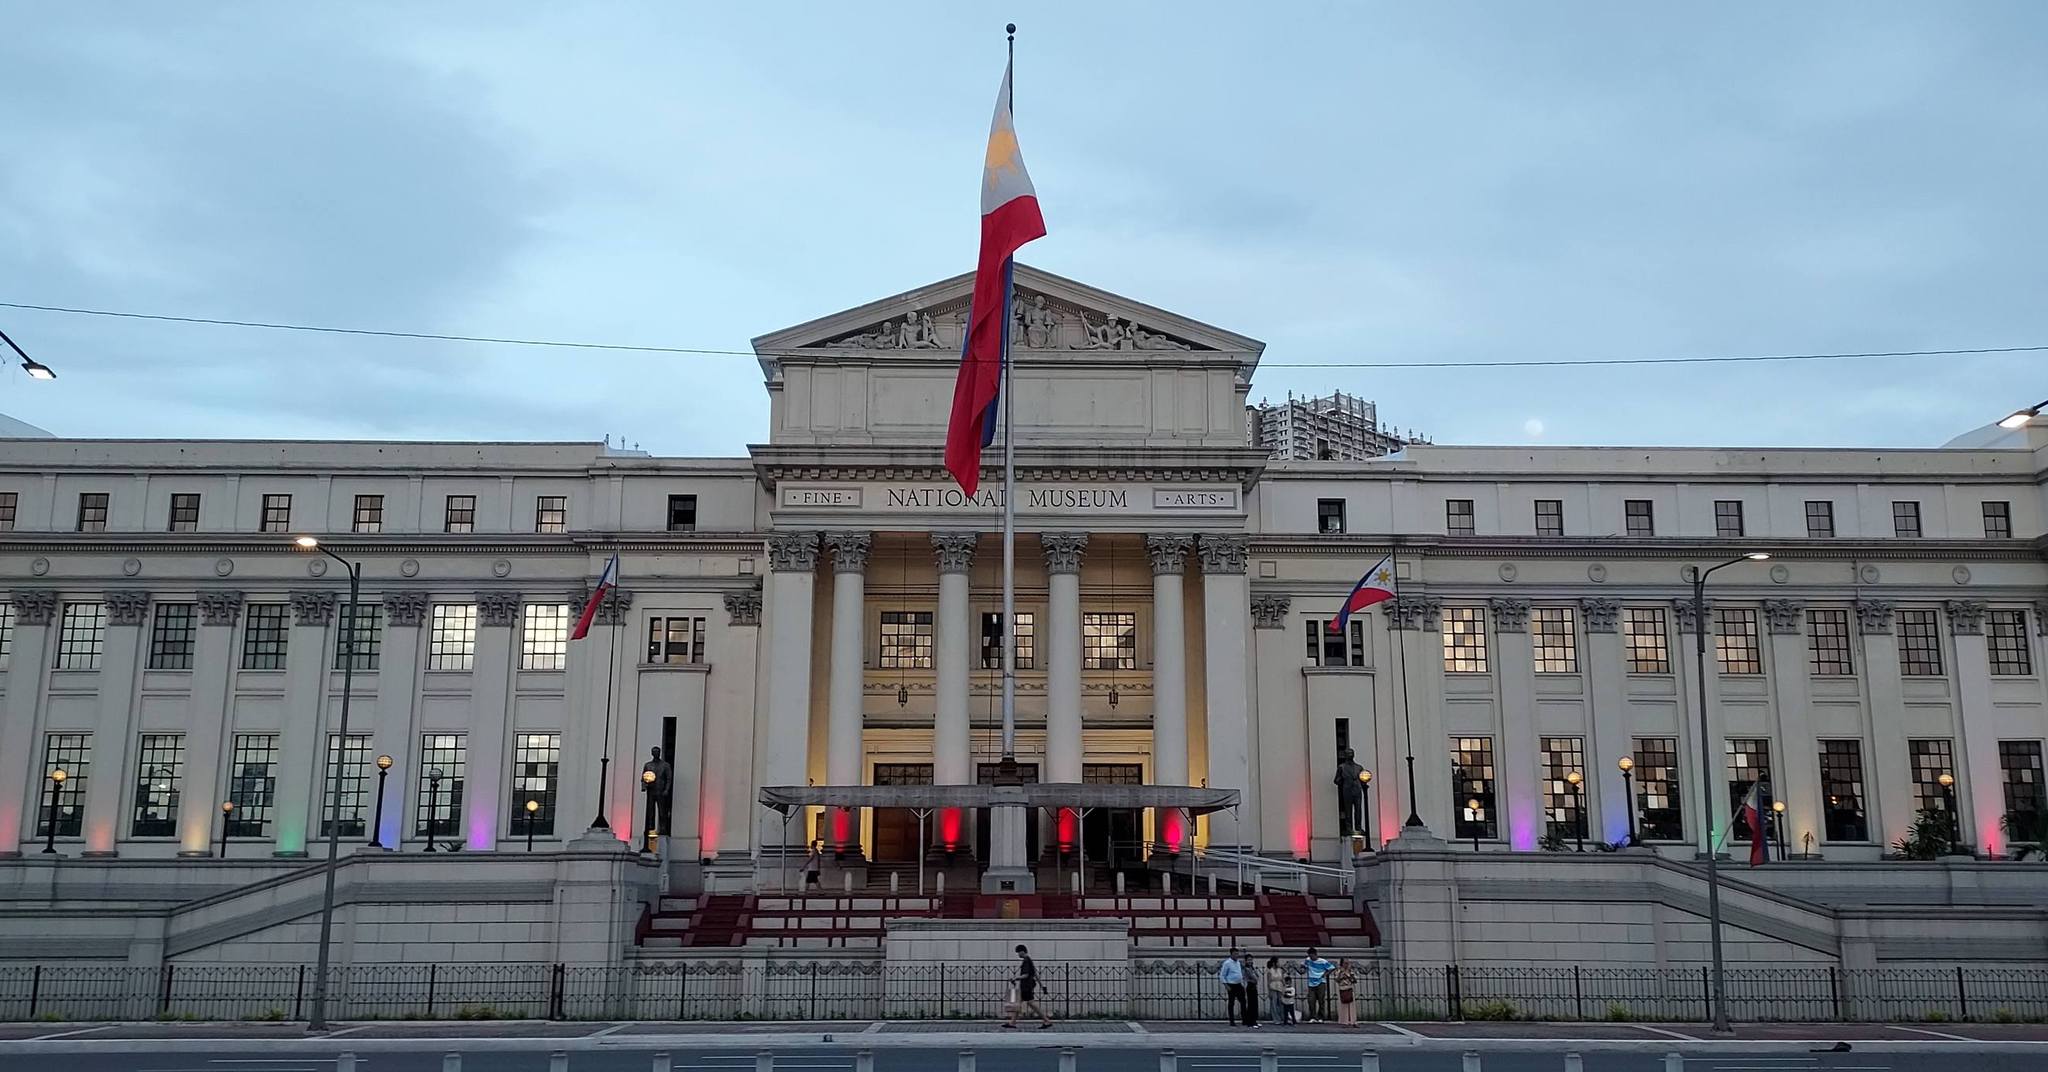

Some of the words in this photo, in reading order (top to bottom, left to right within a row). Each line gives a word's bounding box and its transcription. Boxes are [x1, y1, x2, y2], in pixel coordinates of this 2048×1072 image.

[803, 492, 842, 504] FINE
[1028, 489, 1128, 508] MUSEUM
[1174, 493, 1217, 505] ARTS
